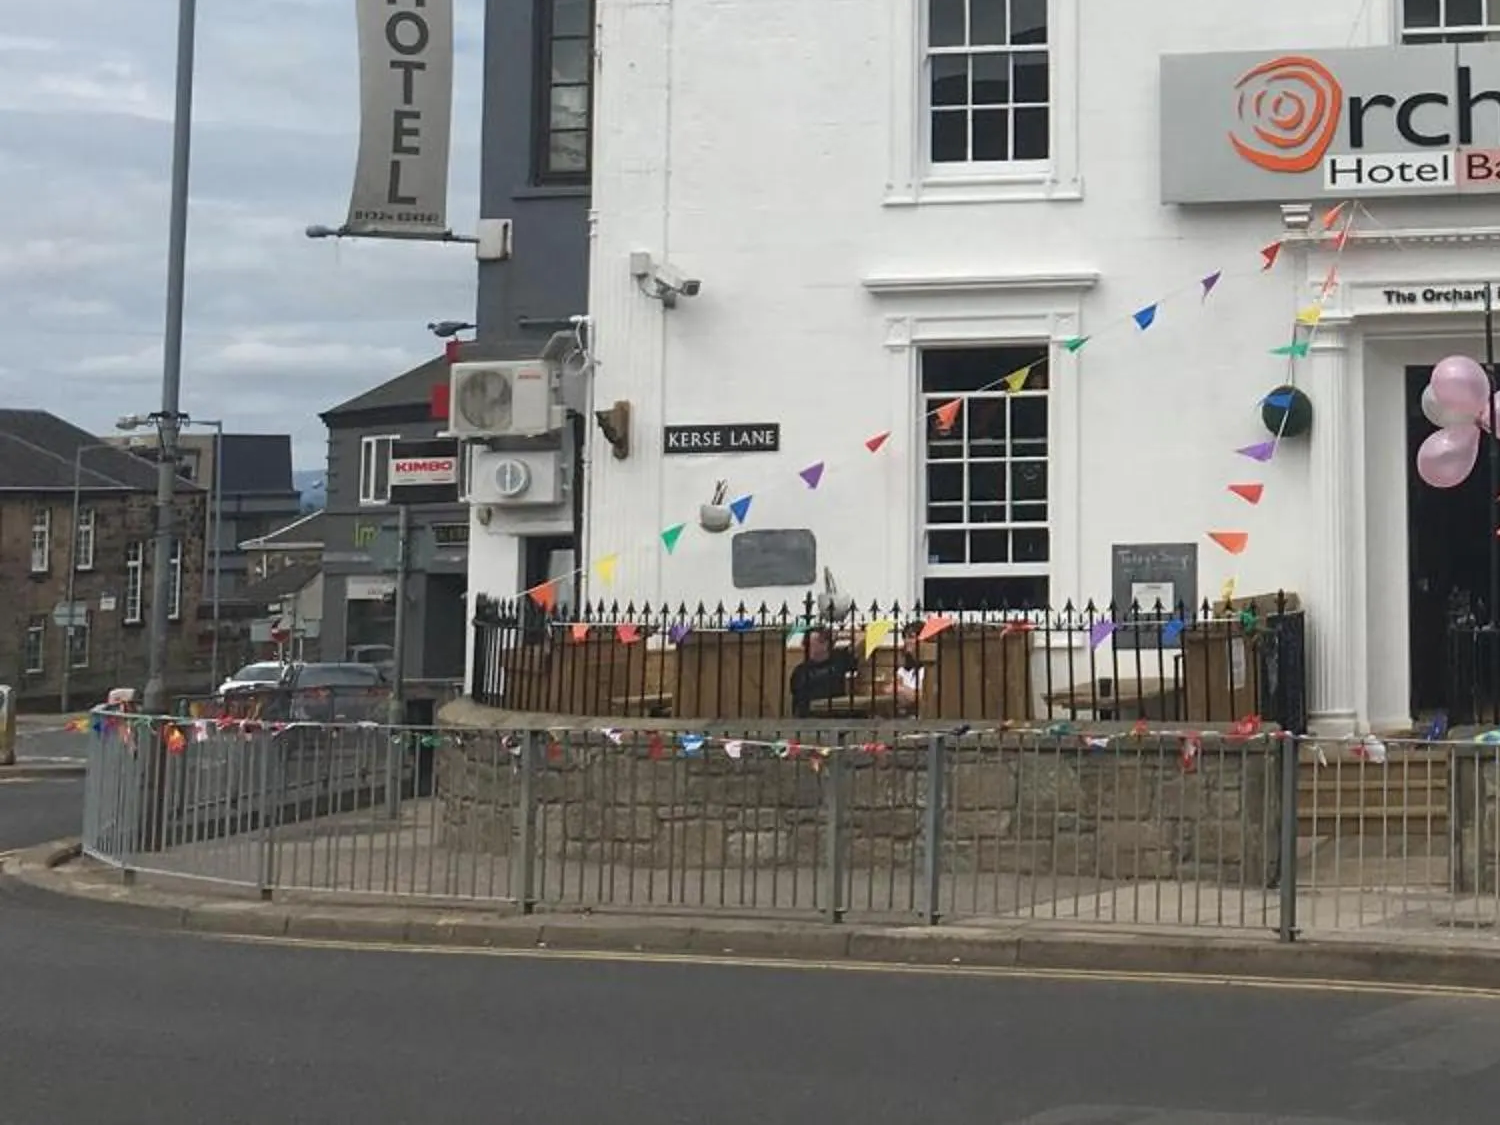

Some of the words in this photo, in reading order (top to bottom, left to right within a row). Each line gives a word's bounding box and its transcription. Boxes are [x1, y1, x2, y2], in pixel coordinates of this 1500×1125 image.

[1330, 155, 1449, 185] Hotel
[1383, 289, 1417, 304] The
[669, 431, 721, 448] KERSE
[731, 430, 775, 446] LANE
[396, 461, 452, 472] KIMBO
